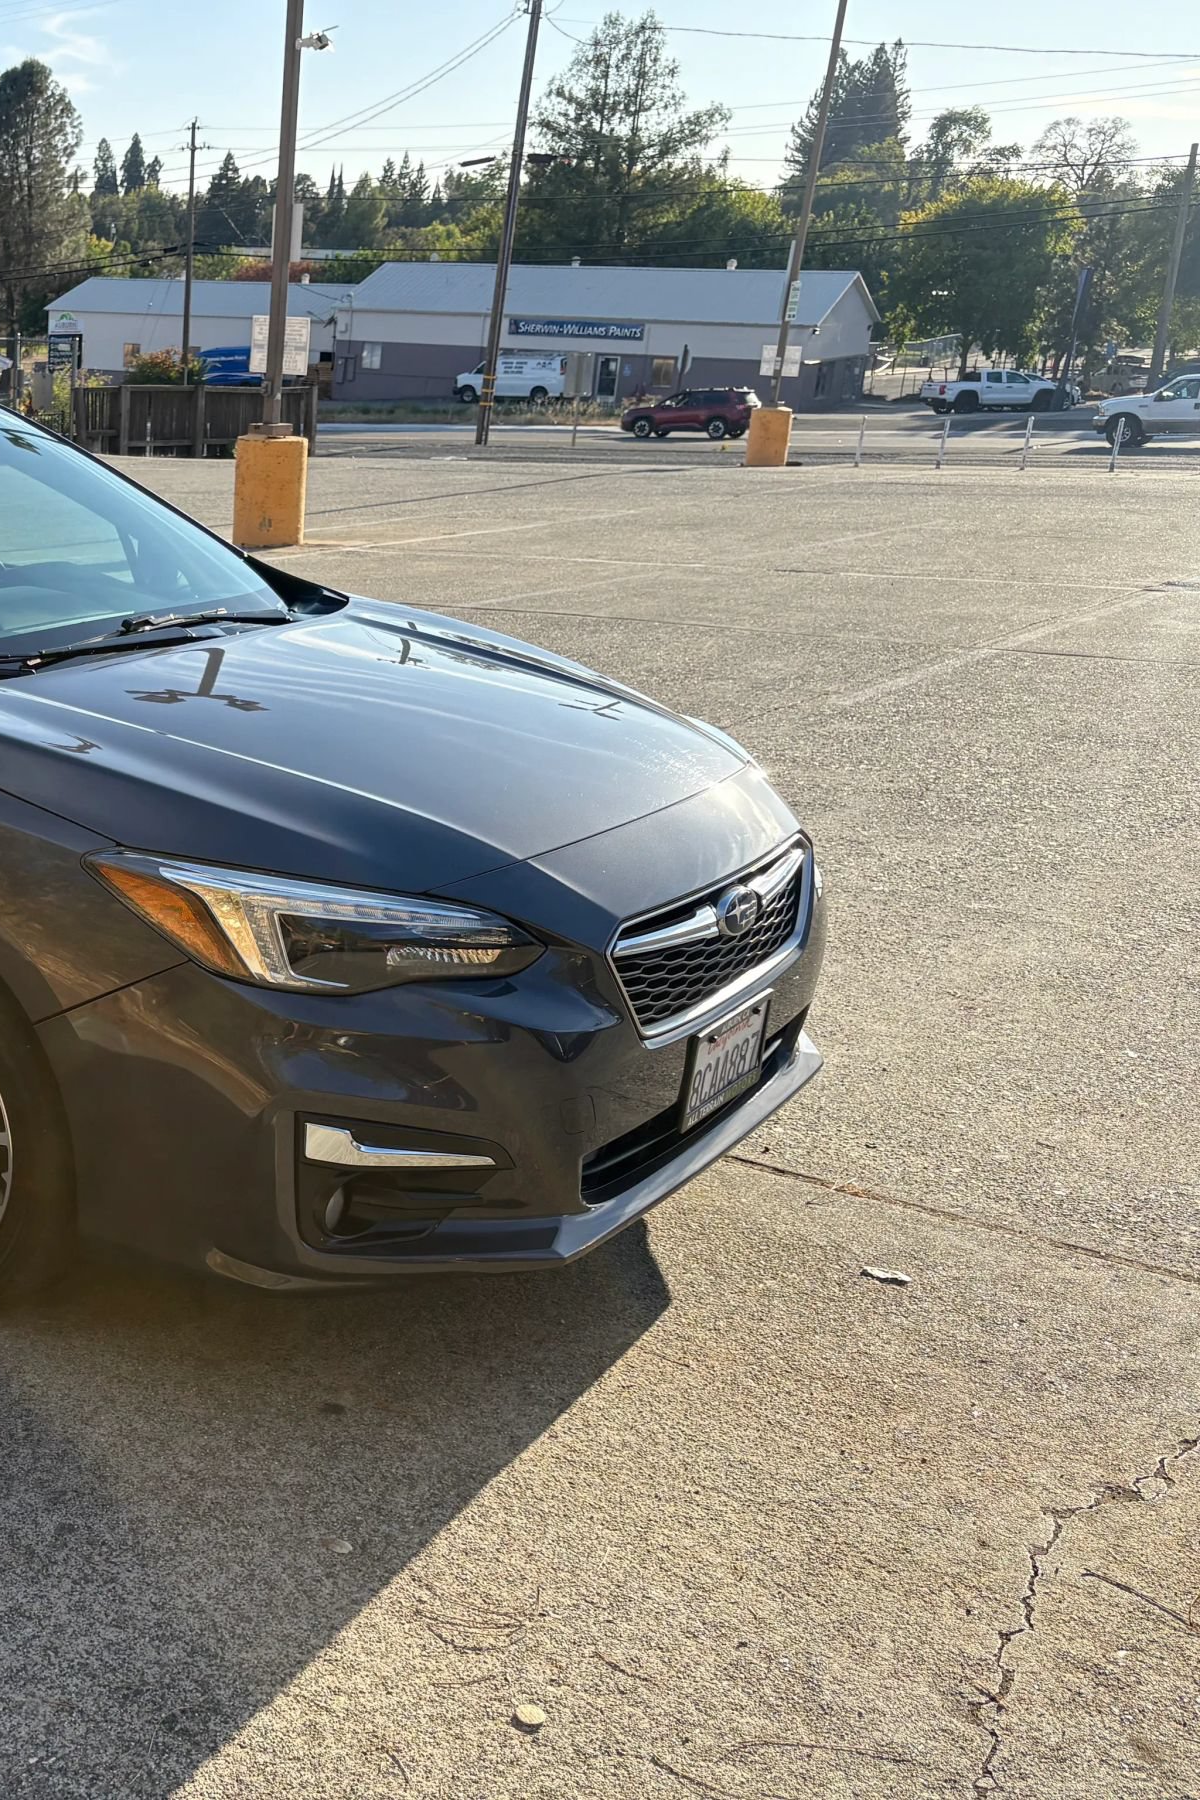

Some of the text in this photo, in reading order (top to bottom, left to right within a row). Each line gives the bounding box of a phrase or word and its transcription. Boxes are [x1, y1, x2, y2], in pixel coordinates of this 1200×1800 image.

[518, 321, 641, 338] SHERWIN-WILLIAMS PAINTS
[688, 1030, 761, 1111] 8CAA887
